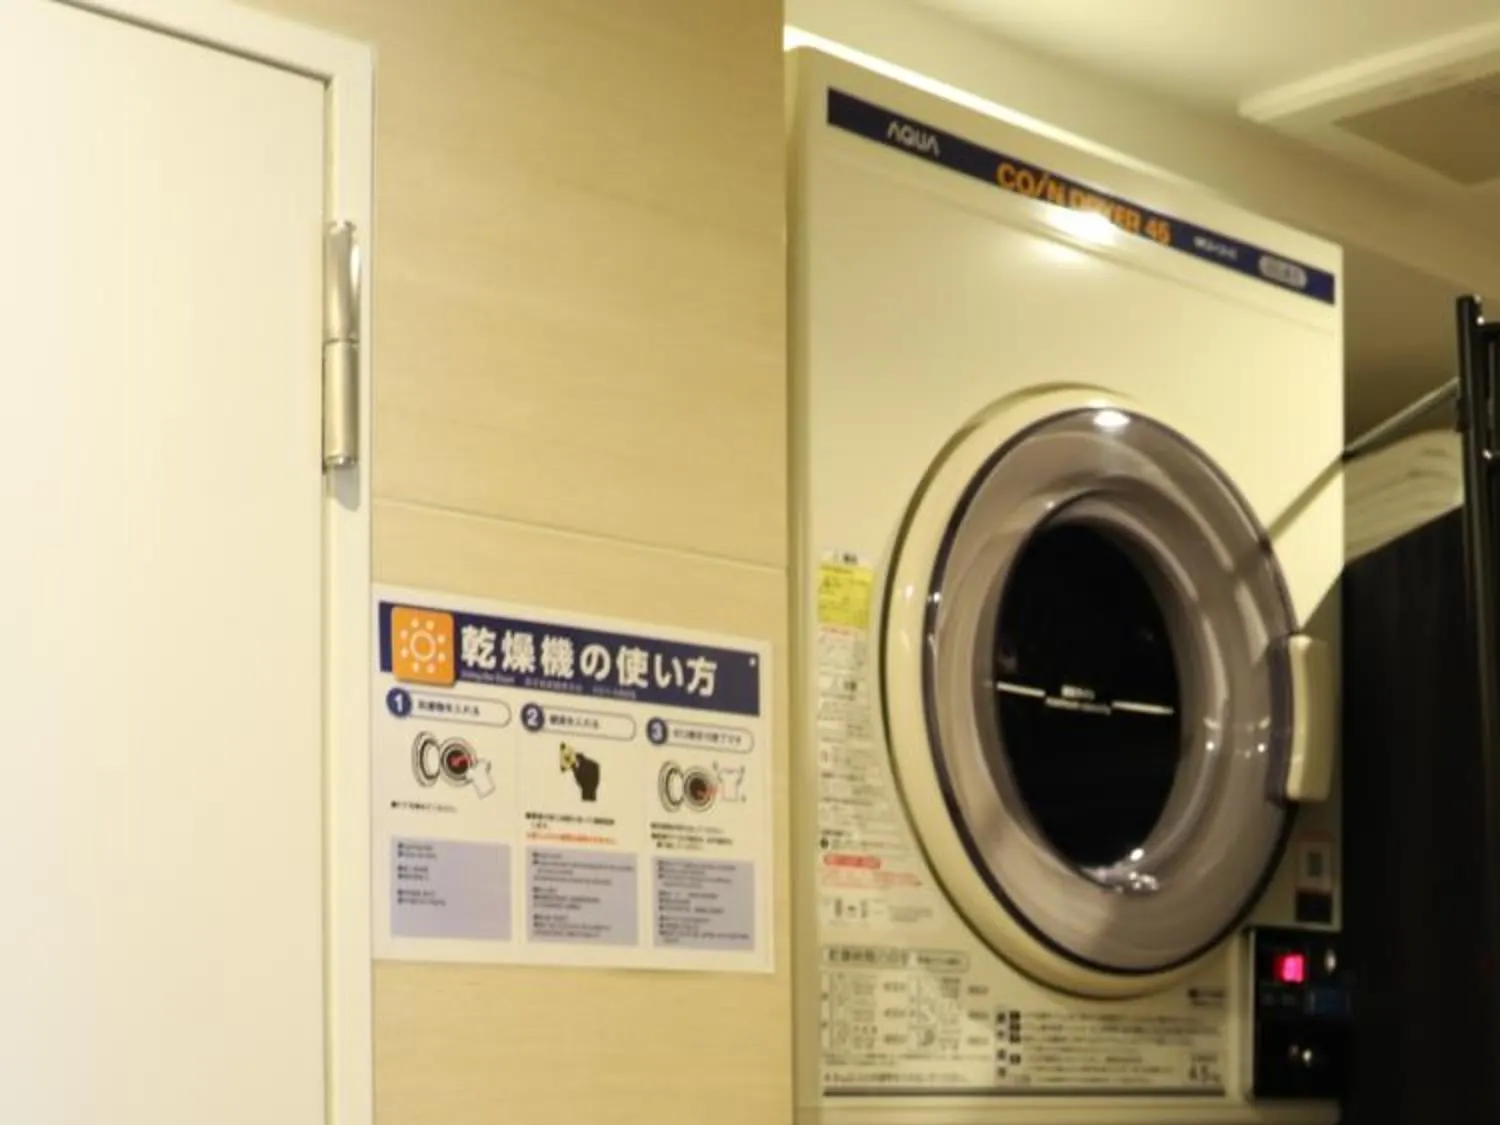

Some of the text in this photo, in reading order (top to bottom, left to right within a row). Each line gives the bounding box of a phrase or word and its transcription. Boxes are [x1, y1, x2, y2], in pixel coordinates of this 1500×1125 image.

[887, 120, 941, 158] AQUA
[460, 625, 718, 698] 乾燥機の使い方
